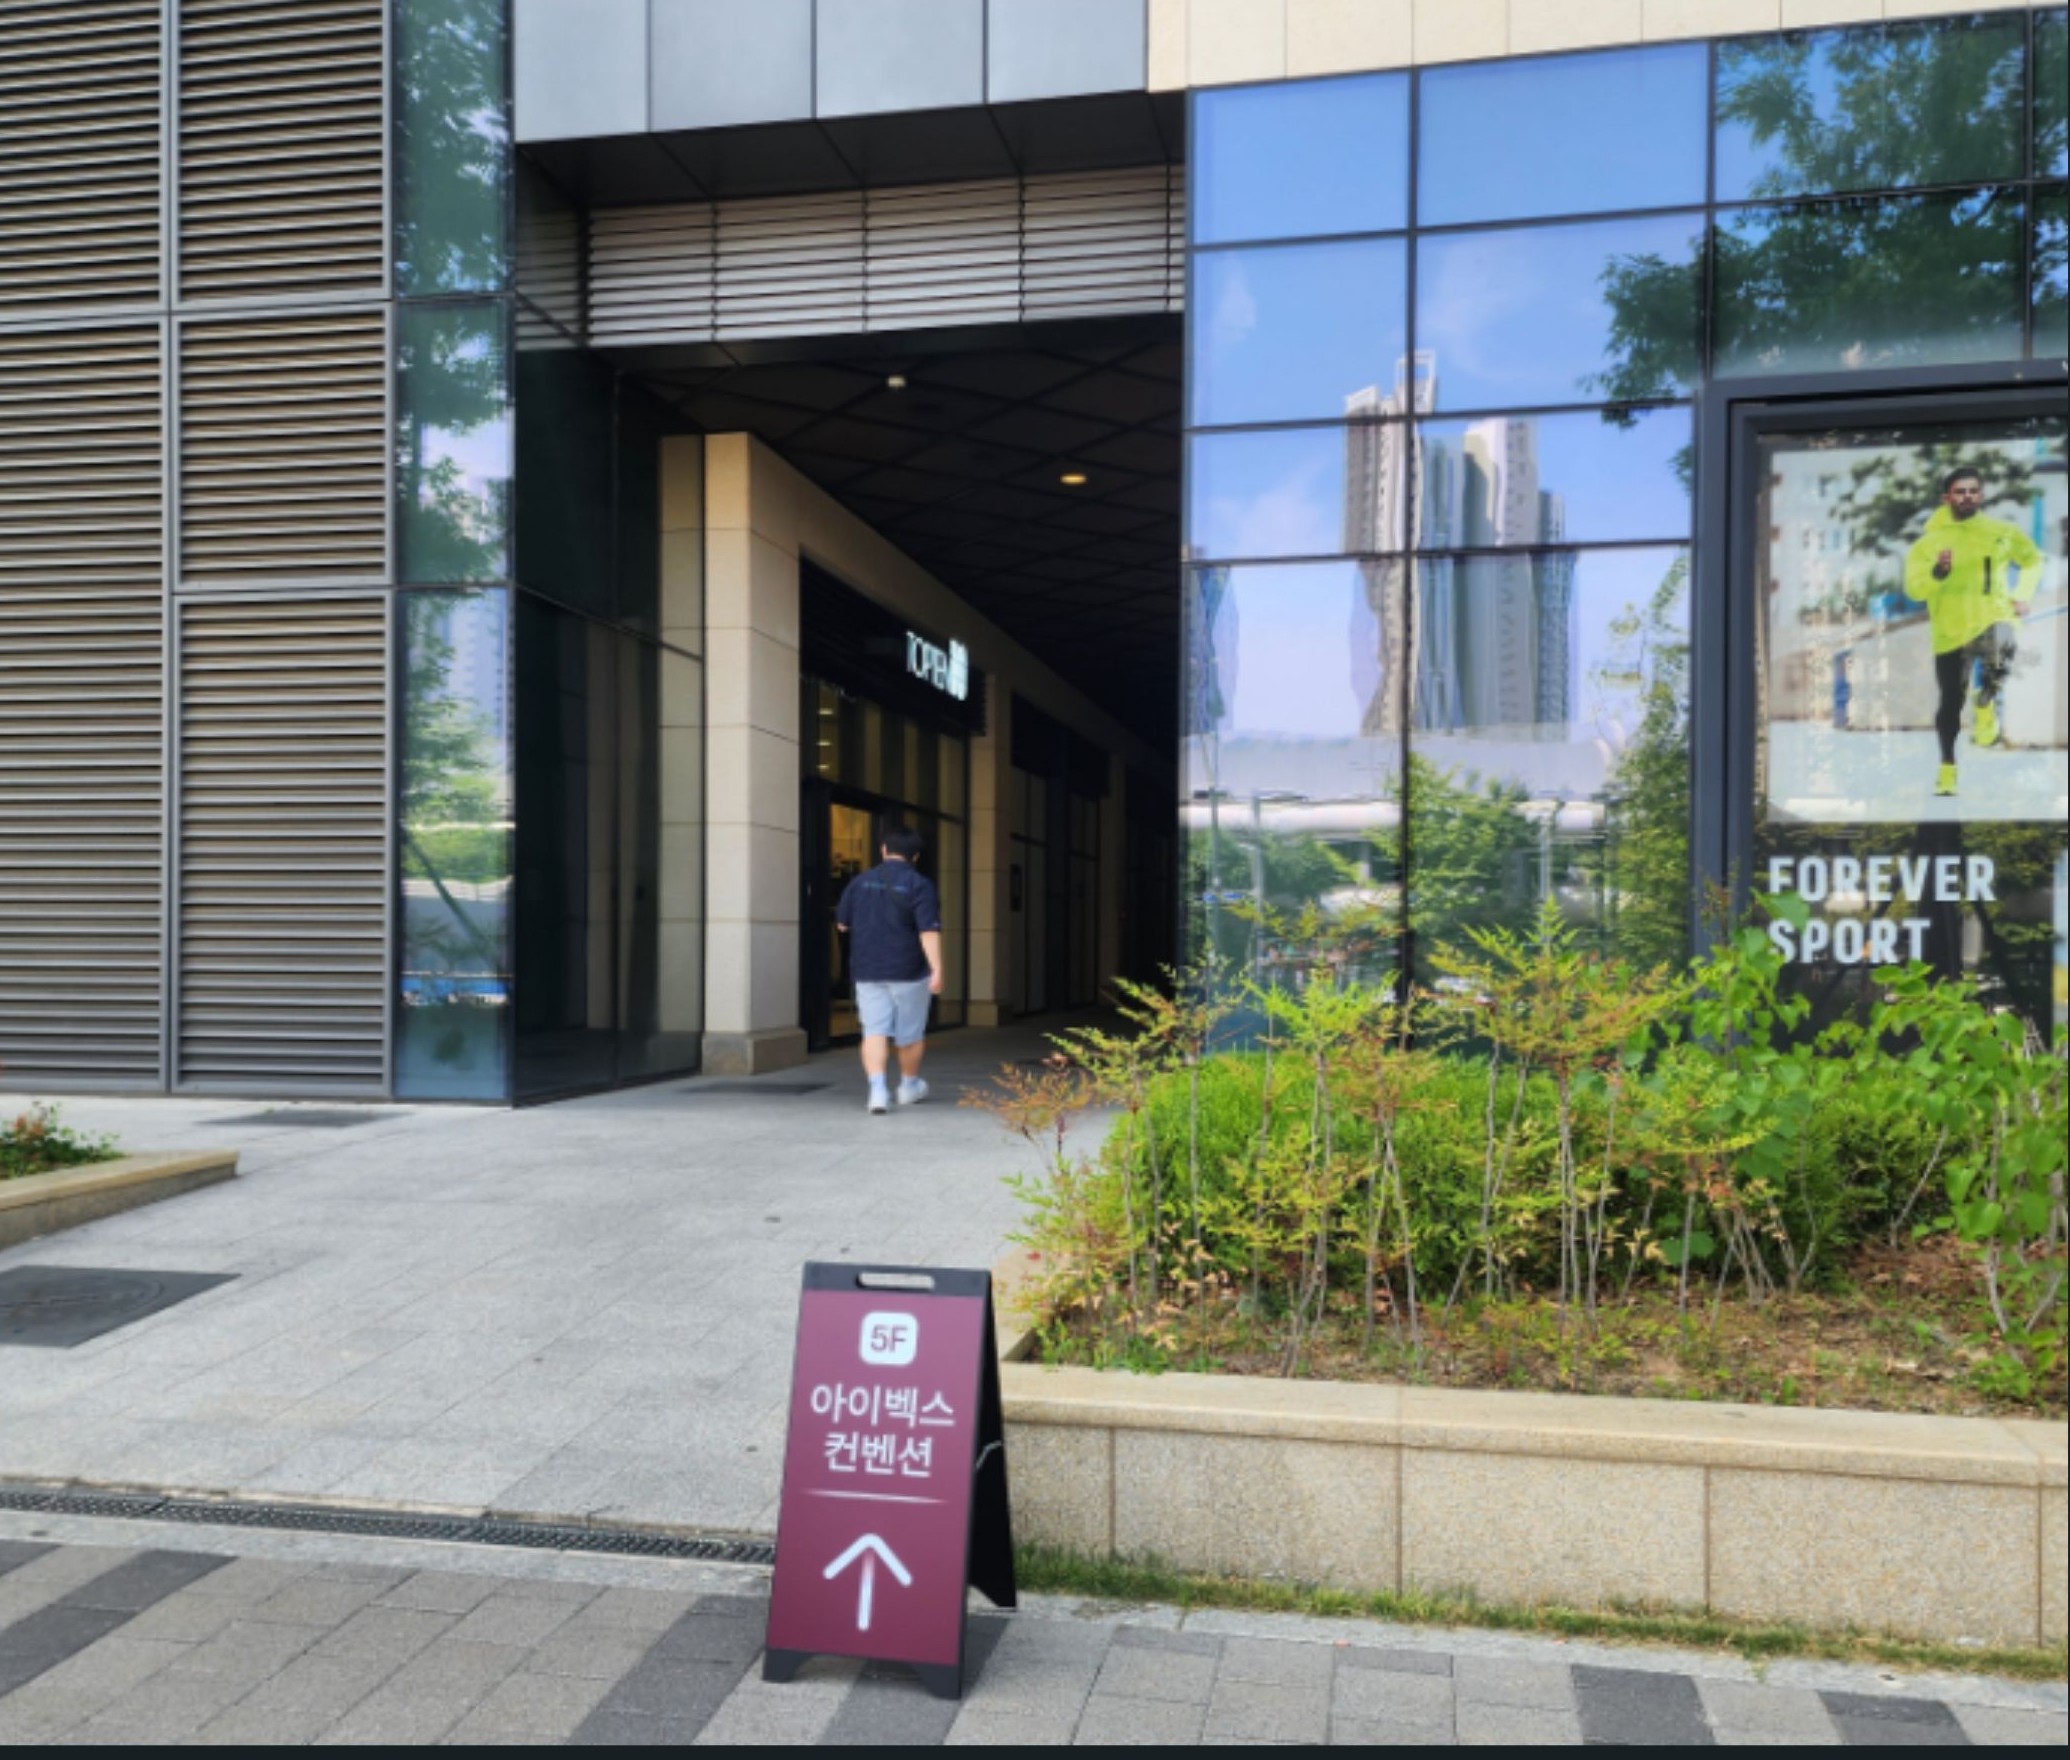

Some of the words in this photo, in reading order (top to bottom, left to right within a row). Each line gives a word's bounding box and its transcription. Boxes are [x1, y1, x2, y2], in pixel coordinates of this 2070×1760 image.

[1769, 855, 1997, 901] FOREVER
[1768, 917, 1931, 964] SPORT
[870, 1324, 908, 1353] 5F
[810, 1382, 956, 1428] 아이벡스
[824, 1431, 933, 1478] 컨벤션
